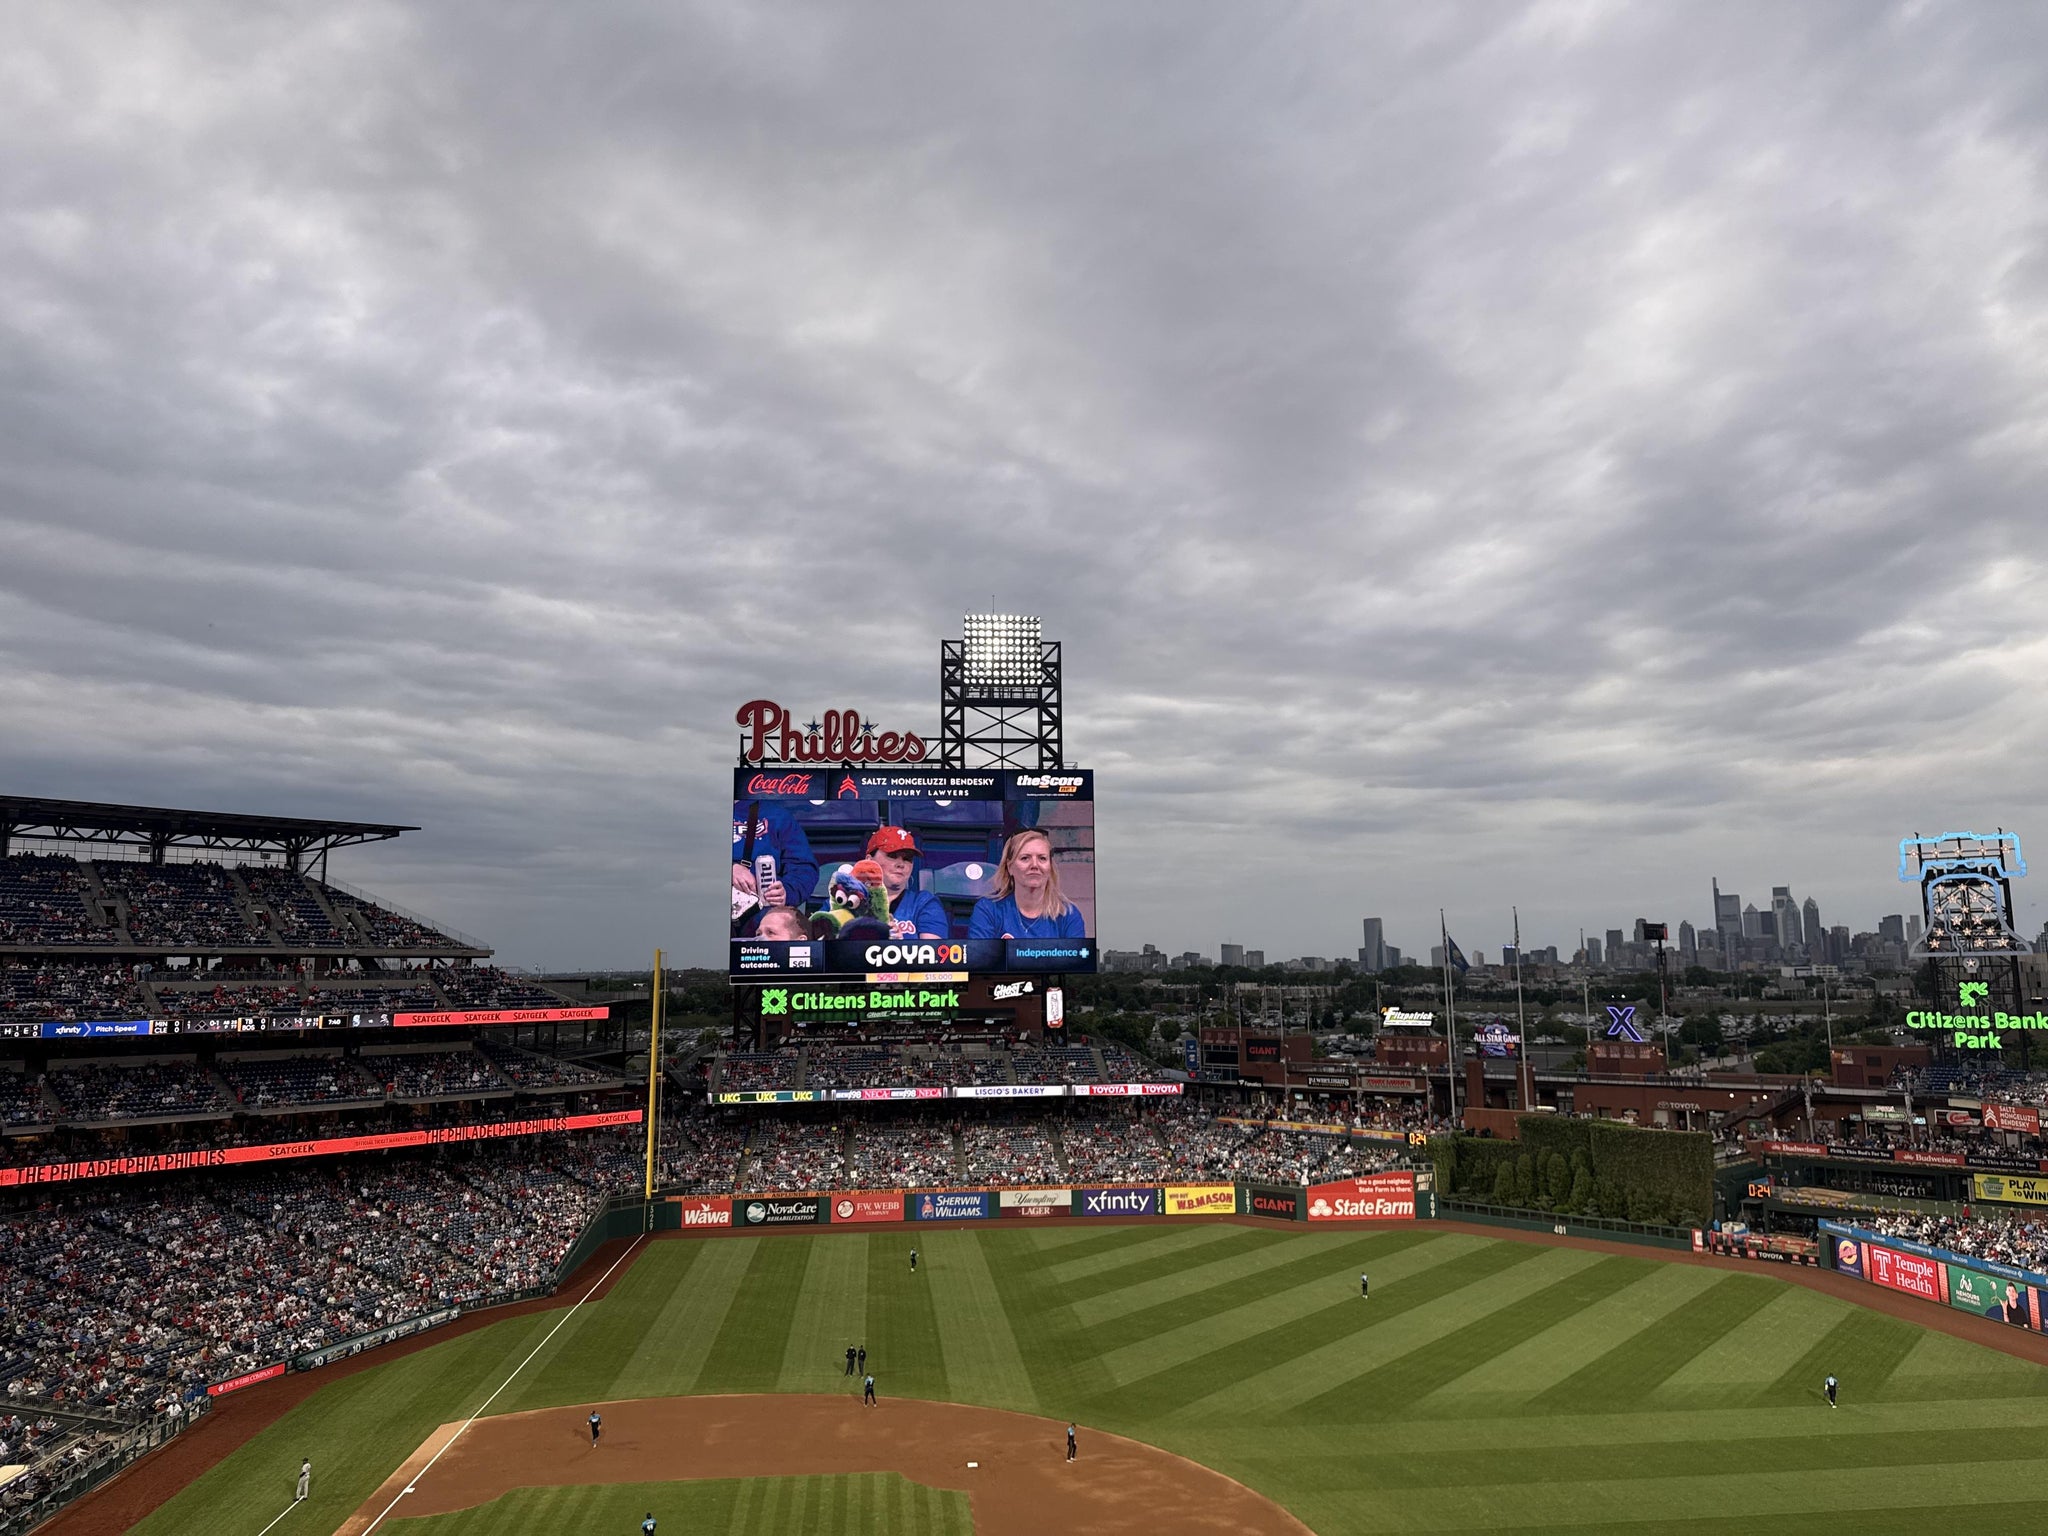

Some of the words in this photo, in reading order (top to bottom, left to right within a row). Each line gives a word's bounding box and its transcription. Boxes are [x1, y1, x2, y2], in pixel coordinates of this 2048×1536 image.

[736, 700, 926, 763] Phillies
[861, 778, 887, 786] SALTZ
[891, 778, 947, 786] MONGELUZZI
[950, 778, 995, 786] BENDESKY
[741, 947, 769, 955] Driving
[865, 945, 935, 966] GOYA
[937, 945, 962, 964] 90
[1016, 948, 1078, 958] Independence
[994, 981, 1025, 1000] GHOST
[791, 992, 866, 1009] Citizens
[870, 990, 916, 1008] Bank
[919, 990, 959, 1007] Park
[464, 1013, 500, 1022] SEATGEEK
[513, 1011, 548, 1020] SEATGEEK
[560, 1009, 594, 1019] SEATGEEK
[1385, 1007, 1433, 1020] Fitzpatrick
[412, 1015, 451, 1024] SEATGEEK
[1906, 1011, 1991, 1029] Citizens
[1994, 1011, 2048, 1029] Bank
[55, 1026, 81, 1035] xfinity
[95, 1025, 113, 1033] Pitch
[114, 1024, 137, 1033] Speed
[1474, 1033, 1485, 1042] ALL
[1487, 1033, 1502, 1042] STAR
[1503, 1033, 1520, 1043] GAME
[1954, 1031, 2002, 1049] Park
[1249, 1046, 1277, 1055] GIANT
[918, 1090, 942, 1098] NECA
[1092, 1086, 1125, 1094] TOYOTA
[1145, 1085, 1178, 1093] TOYOTA
[719, 1094, 741, 1102] UKG
[756, 1093, 777, 1101] UKG
[792, 1091, 813, 1100] UKG
[864, 1090, 889, 1099] NECA
[1999, 1105, 2015, 1114] SALTZ
[597, 1113, 630, 1124] SEATGEEK
[425, 1129, 445, 1144] THE
[447, 1121, 522, 1142] PHILADELPHIA
[525, 1117, 567, 1135] PHILLIES
[1409, 1132, 1426, 1145] 0:24
[269, 1143, 315, 1157] SEATGEEK
[1782, 1144, 1820, 1153] Budweiser
[1916, 1153, 1957, 1164] Budweiser
[16, 1166, 45, 1184] THE
[50, 1155, 161, 1180] PHILADELPHIA
[165, 1150, 225, 1171] PHILLIES
[2009, 1180, 2036, 1190] PLAY
[1748, 1184, 1771, 1198] 0:24
[936, 1195, 981, 1206] SHERWIN
[1014, 1193, 1059, 1205] Yuengling
[1087, 1191, 1150, 1212] xfinity
[767, 1203, 817, 1215] NovaCare
[874, 1202, 900, 1210] WEBB
[1254, 1197, 1295, 1212] GIANT
[1021, 1206, 1051, 1215] LAGER
[685, 1210, 730, 1224] Wawa
[1553, 1224, 1566, 1235] 401
[1903, 1242, 1928, 1253] Independence
[1759, 1251, 1784, 1260] TOYOTA
[1894, 1254, 1933, 1278] Temple
[1988, 1264, 2017, 1276] Independence
[1896, 1271, 1934, 1295] Health
[1956, 1289, 1980, 1301] NEMOURS
[353, 1343, 361, 1353] 10
[315, 1356, 324, 1366] 10
